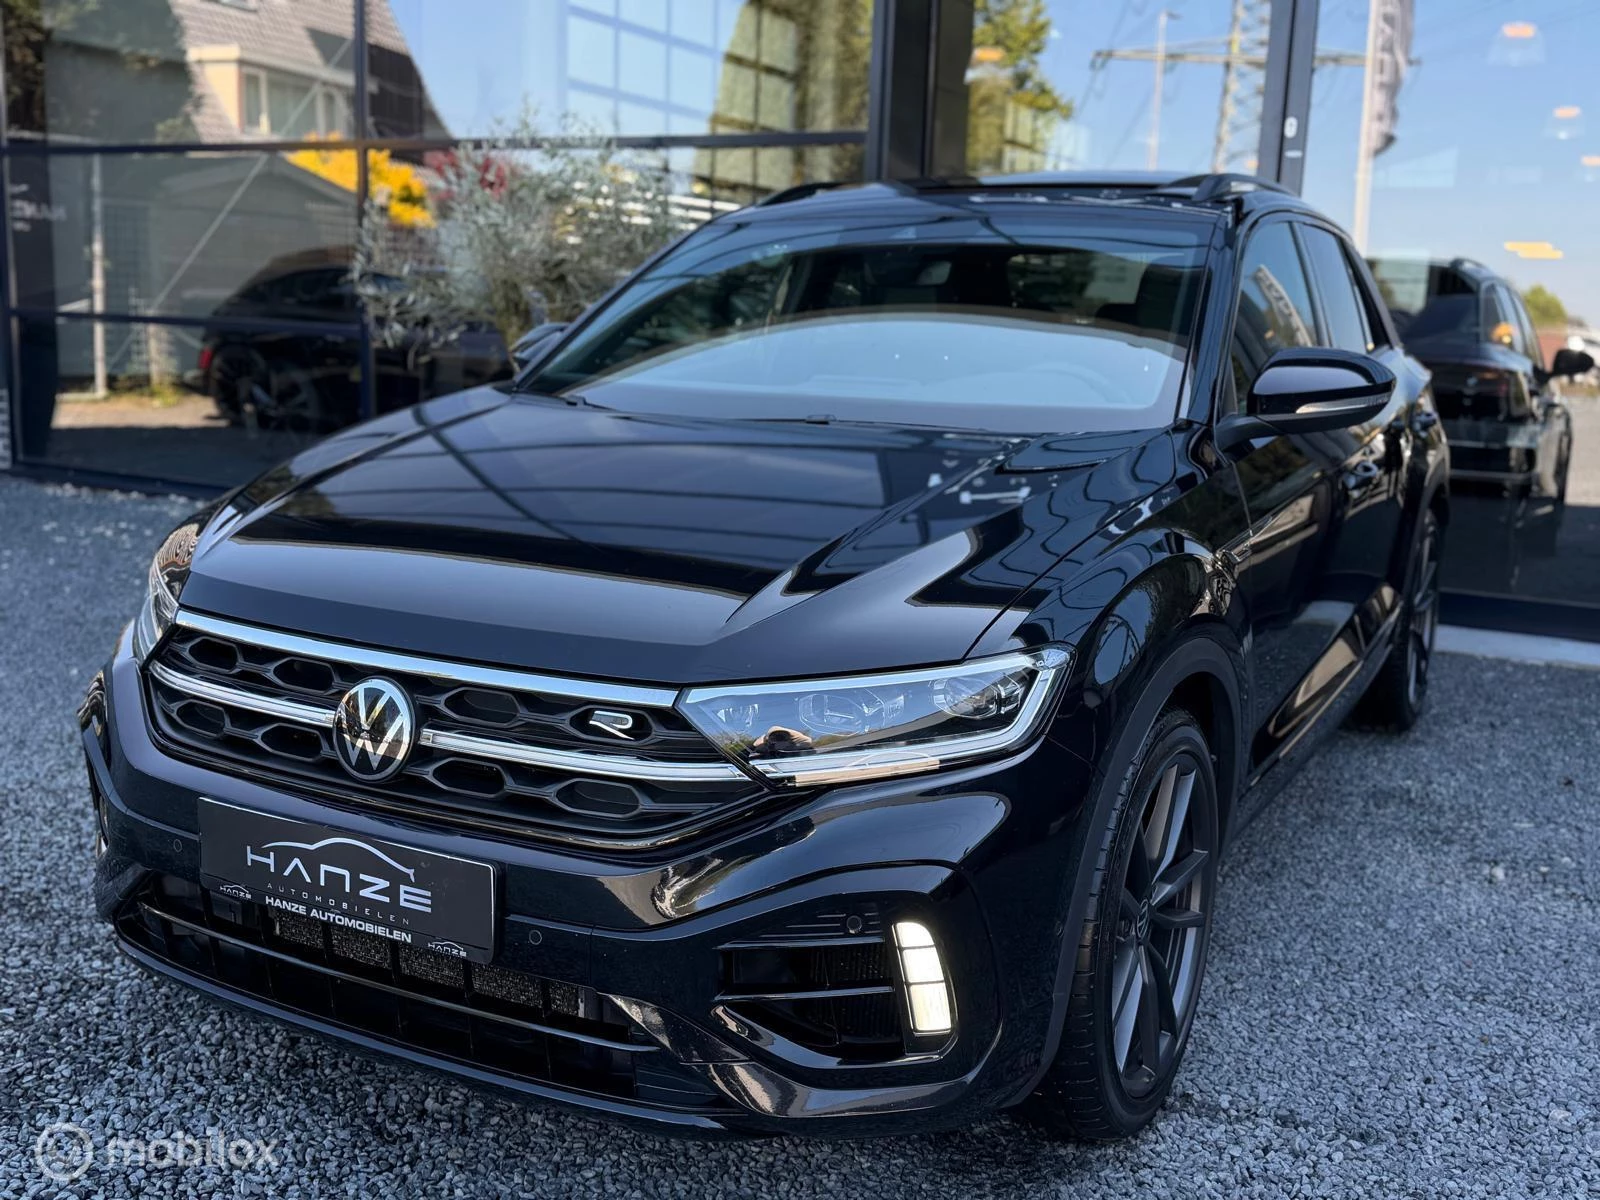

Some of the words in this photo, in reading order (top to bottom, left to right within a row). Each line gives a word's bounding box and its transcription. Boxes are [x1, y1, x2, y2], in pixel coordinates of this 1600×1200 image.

[589, 710, 635, 740] R
[247, 845, 431, 913] HANZE
[265, 895, 307, 915] HANZE
[310, 908, 412, 943] AUTOMOBIELEN
[267, 882, 409, 925] AUTOMOBIELEN
